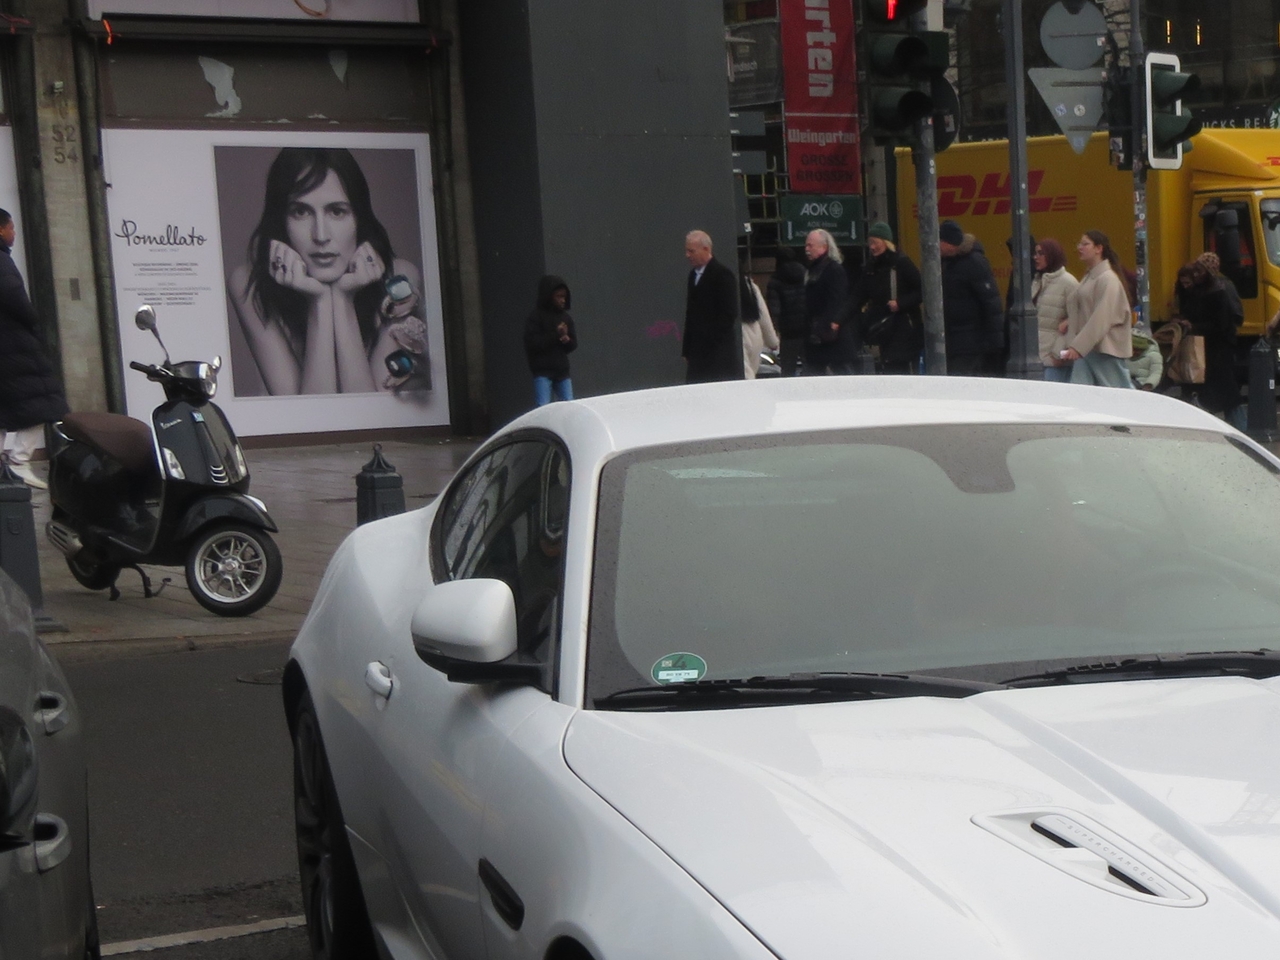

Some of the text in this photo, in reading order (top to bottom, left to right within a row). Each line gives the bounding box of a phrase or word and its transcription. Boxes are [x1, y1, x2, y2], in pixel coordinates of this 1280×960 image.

[805, 0, 836, 97] rten
[52, 125, 76, 142] 52
[787, 128, 857, 147] Weingarten
[54, 146, 78, 163] 54
[935, 170, 1053, 217] DHL
[800, 202, 829, 216] AOK
[114, 219, 207, 247] Pomellato
